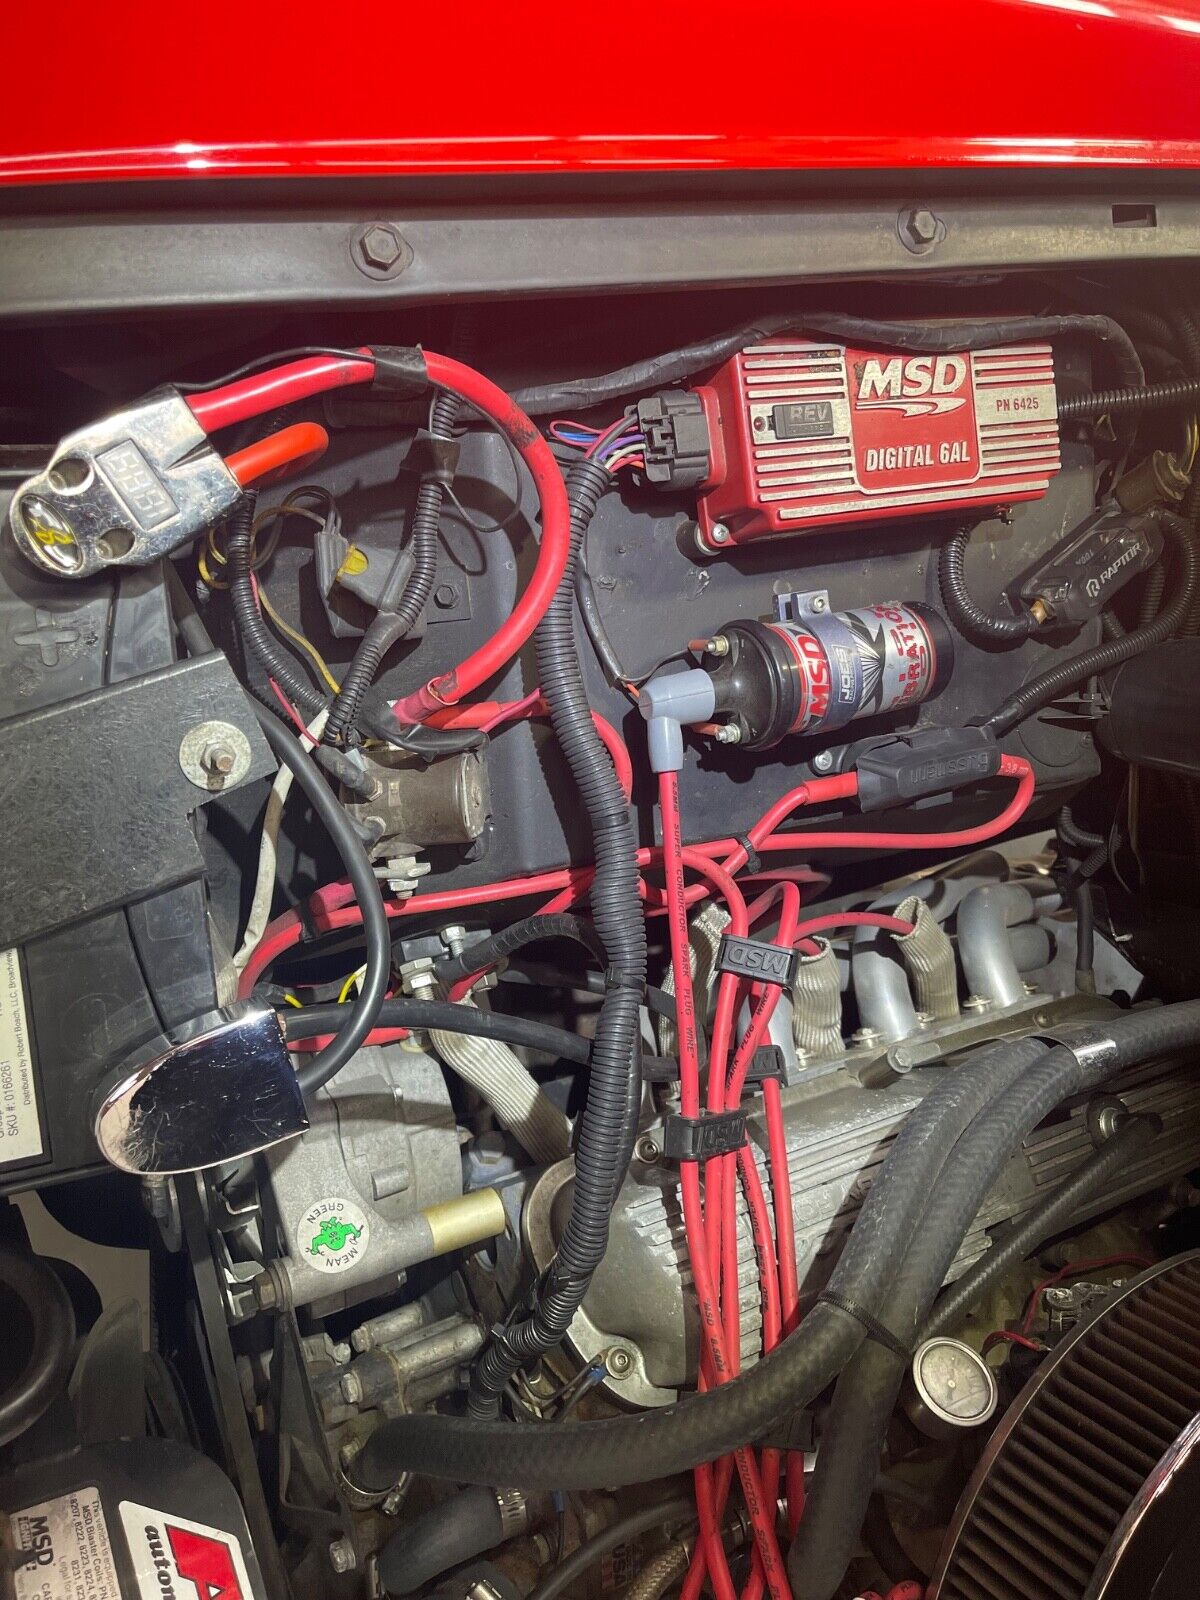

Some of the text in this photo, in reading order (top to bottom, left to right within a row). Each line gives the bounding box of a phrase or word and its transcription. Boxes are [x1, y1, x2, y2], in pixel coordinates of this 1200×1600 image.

[857, 356, 967, 399] MSD
[790, 402, 830, 421] REV
[995, 397, 1039, 412] PN 6425
[865, 440, 970, 472] DIGITAL 6AL
[1100, 543, 1143, 585] RAPTOR
[797, 636, 830, 717] MSD
[834, 647, 851, 700] JOES
[911, 753, 988, 783] Bussmann
[673, 824, 681, 858] SUPER
[676, 870, 686, 933] CONDUCTOR
[681, 943, 690, 979] SPARK
[728, 946, 786, 974] MSD
[684, 987, 693, 1016] PLUG
[15, 1033, 25, 1057] Robert
[740, 1024, 755, 1051] PLUG
[21, 1068, 31, 1106] Distributed
[7, 1113, 19, 1137] SKU
[306, 1202, 358, 1267] MEAN GREEN
[82, 1505, 94, 1525] MSD
[29, 1515, 54, 1566] MSD
[86, 1526, 99, 1557] Blaster
[756, 1529, 775, 1573] SPARK
